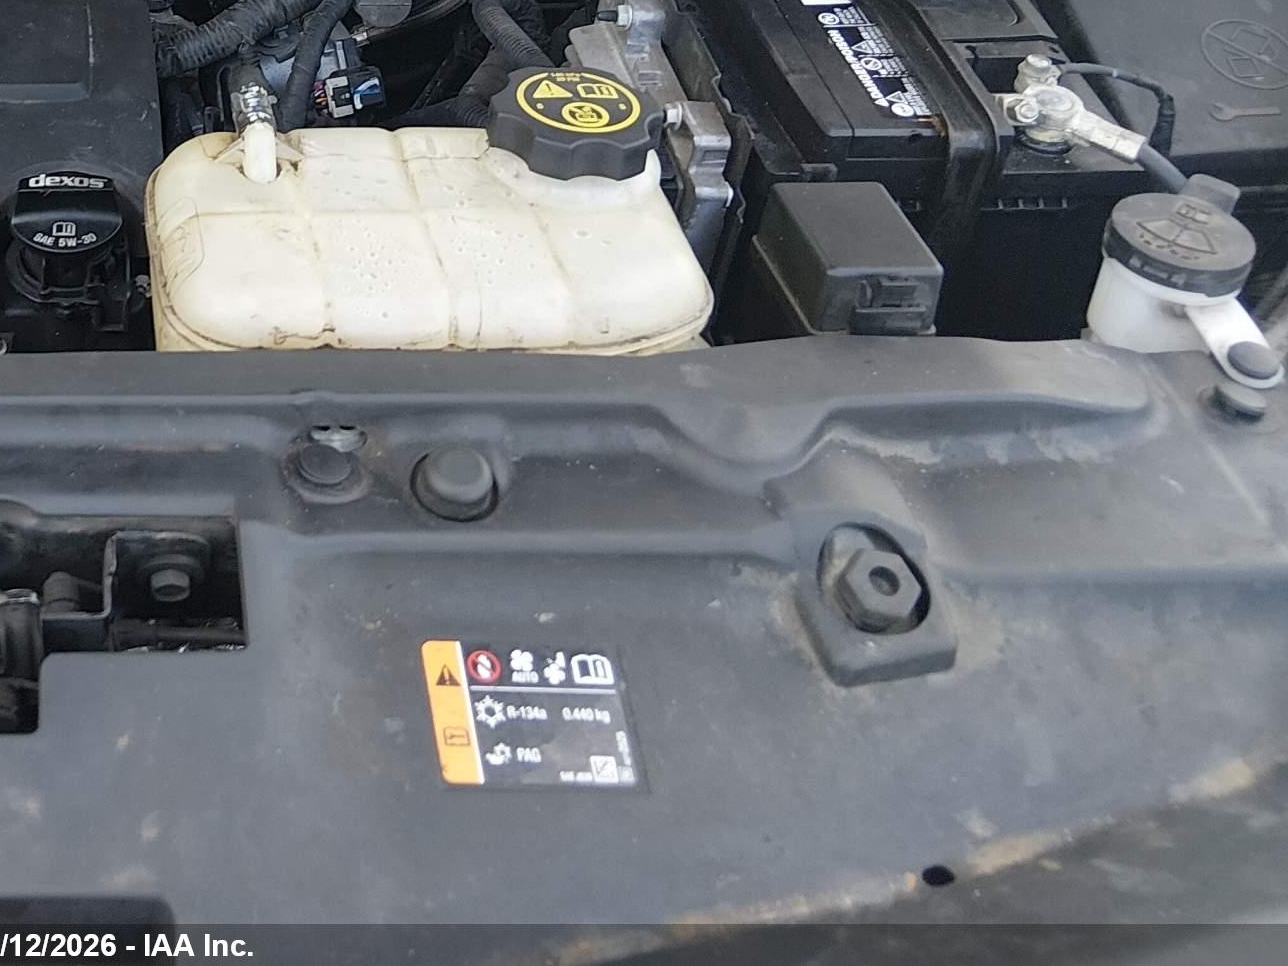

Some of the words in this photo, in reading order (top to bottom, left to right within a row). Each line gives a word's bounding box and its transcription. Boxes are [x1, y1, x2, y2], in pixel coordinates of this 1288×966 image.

[28, 173, 108, 189] dexos
[33, 233, 55, 246] SAE
[58, 233, 97, 248] 5W-30
[512, 670, 539, 683] AUTO
[507, 705, 548, 721] R-134a
